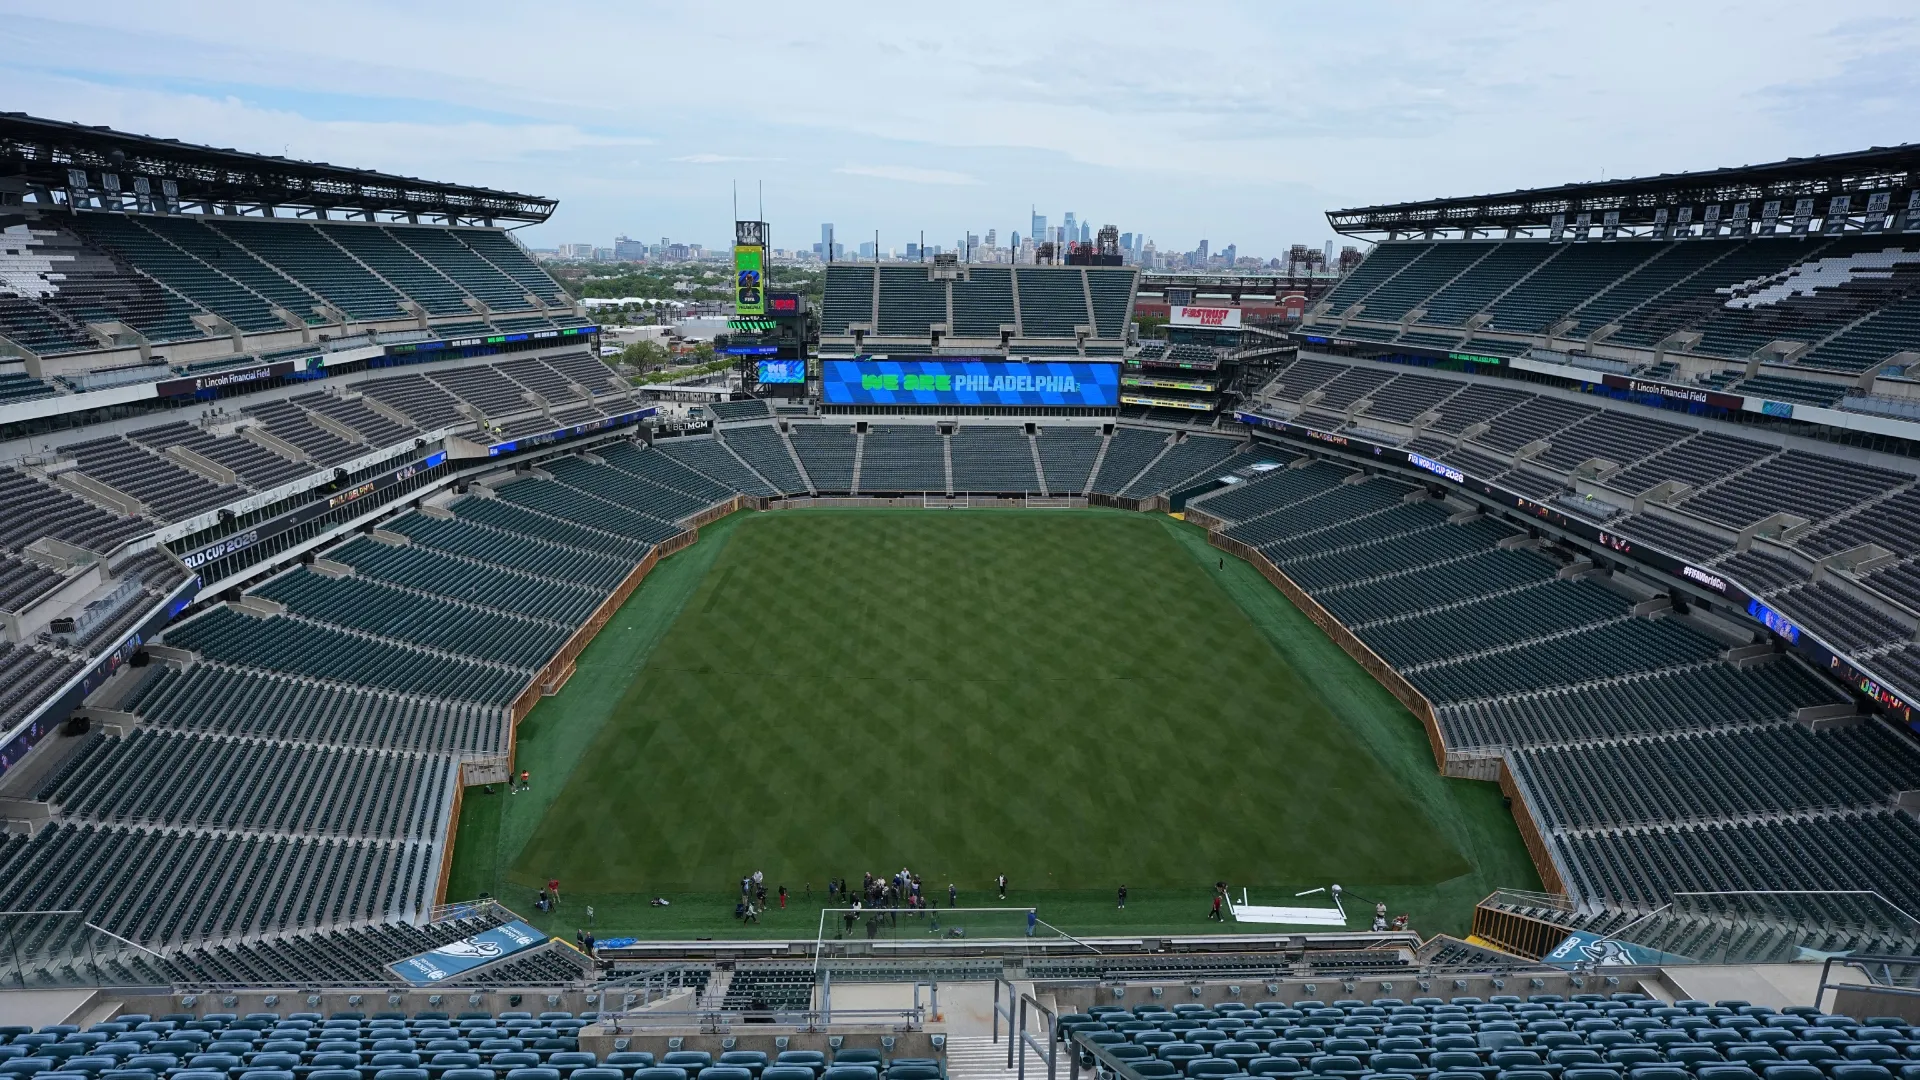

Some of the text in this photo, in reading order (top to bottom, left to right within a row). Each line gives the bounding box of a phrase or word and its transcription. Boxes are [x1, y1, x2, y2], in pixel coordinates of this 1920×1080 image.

[204, 367, 270, 388] Lincoln Financial Field
[862, 374, 899, 391] WE
[903, 374, 952, 391] ARE
[955, 374, 1076, 393] PHILADELPHIA
[1637, 382, 1707, 402] Lincoln Financial Field
[1419, 457, 1436, 471] WORLD
[1436, 465, 1446, 475] CUP
[1445, 469, 1464, 483] 2026
[206, 544, 225, 560] CUP
[226, 530, 258, 553] 2026
